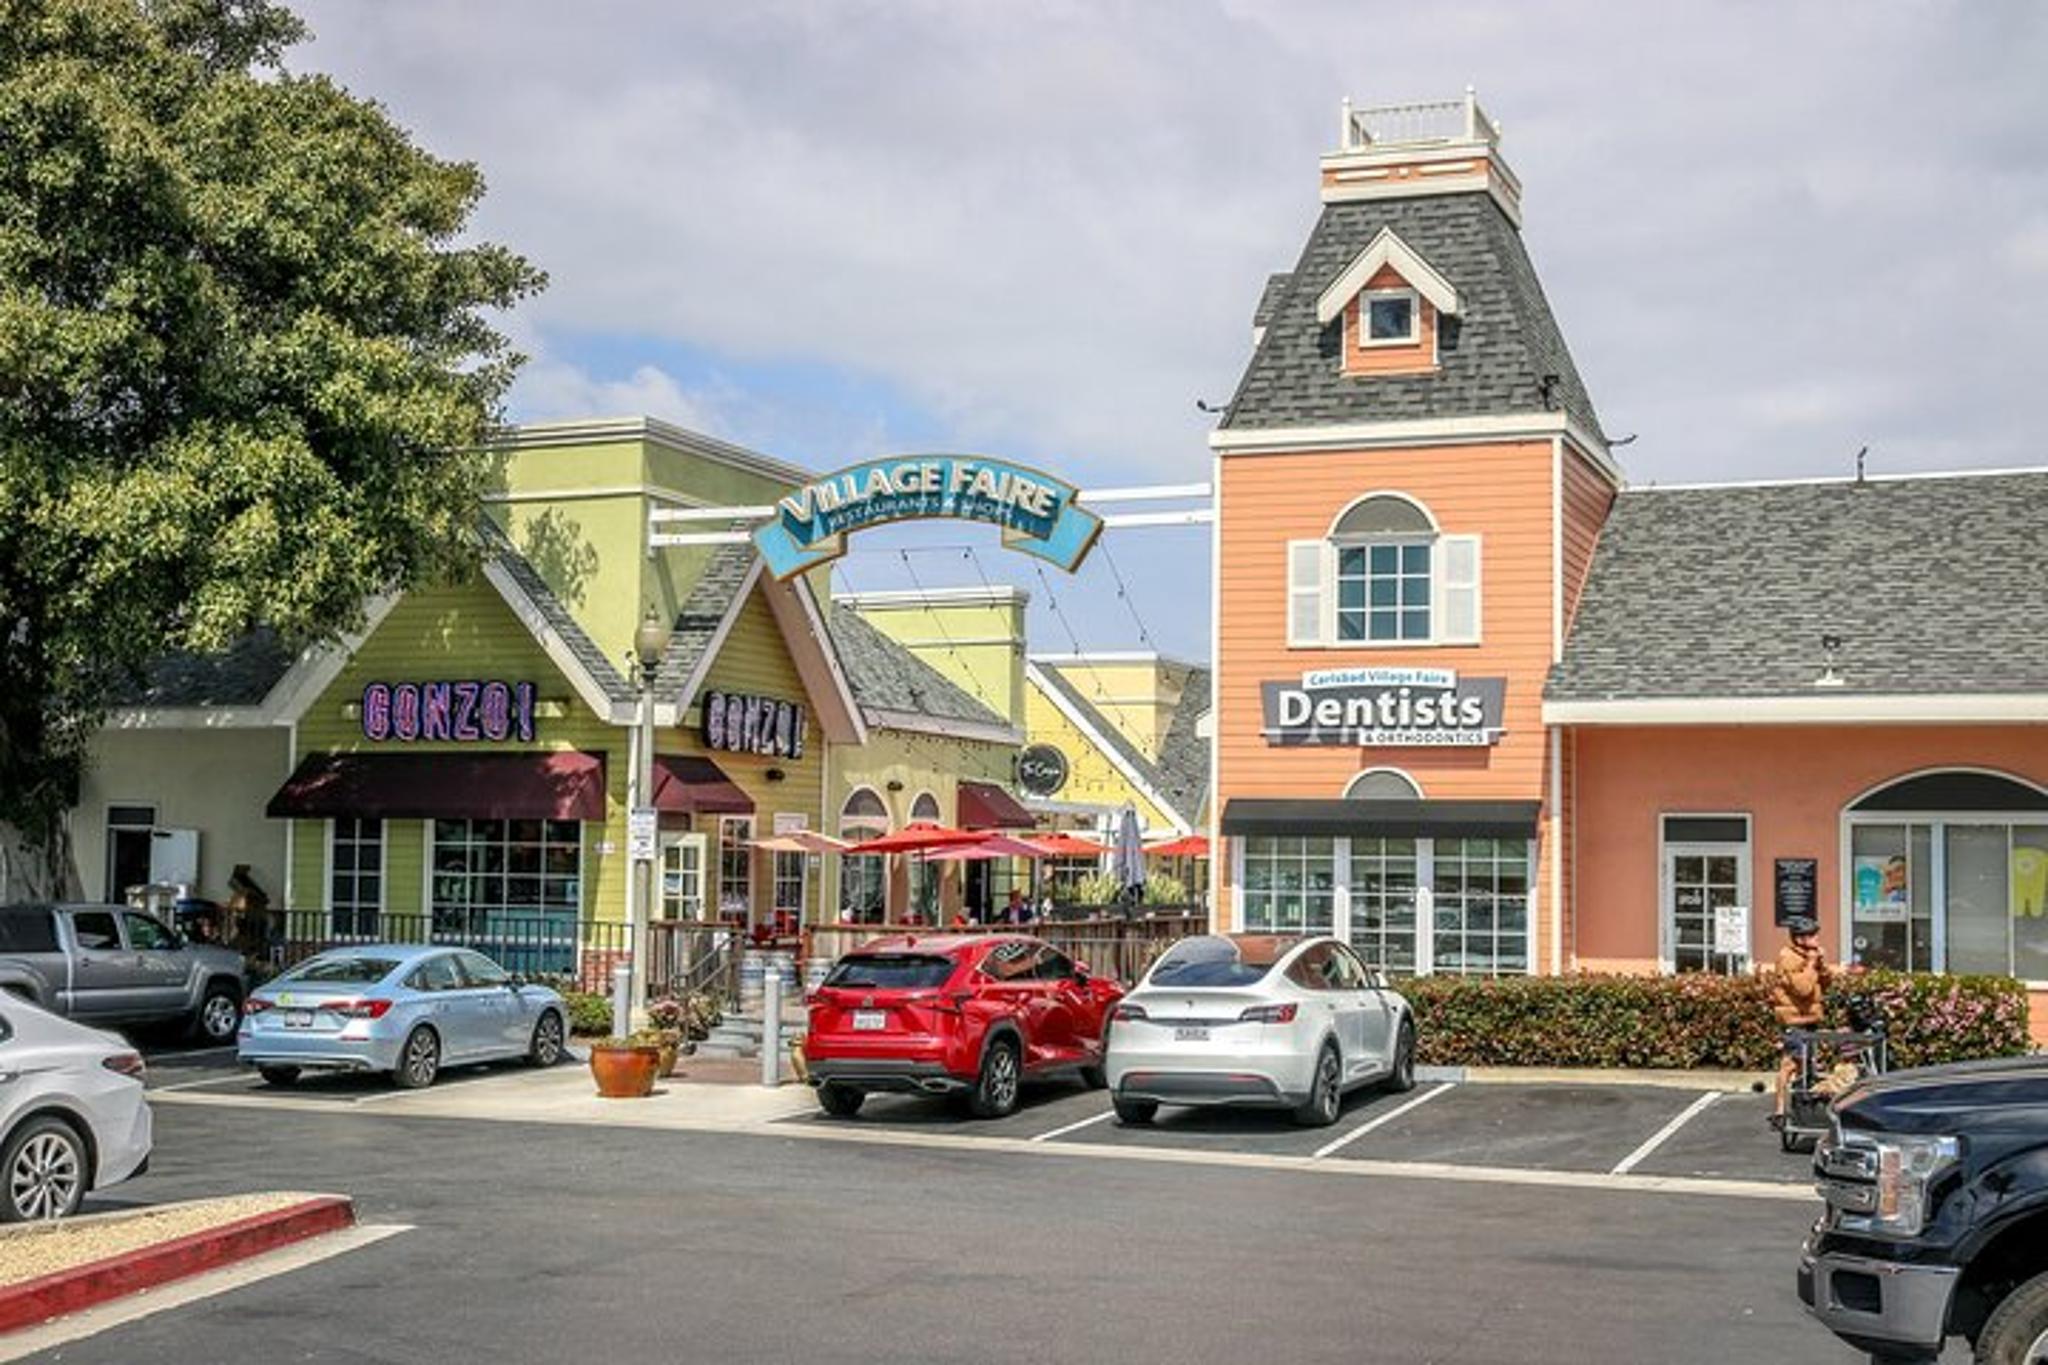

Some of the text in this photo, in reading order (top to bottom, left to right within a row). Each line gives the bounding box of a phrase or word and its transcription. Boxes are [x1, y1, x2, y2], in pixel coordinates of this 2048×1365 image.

[779, 461, 1058, 522] VILLAGE FAIRE
[1310, 670, 1448, 686] Carlsbad Village Faire
[1278, 688, 1484, 728] Dentists
[1377, 732, 1483, 744] ORTHODONTICS
